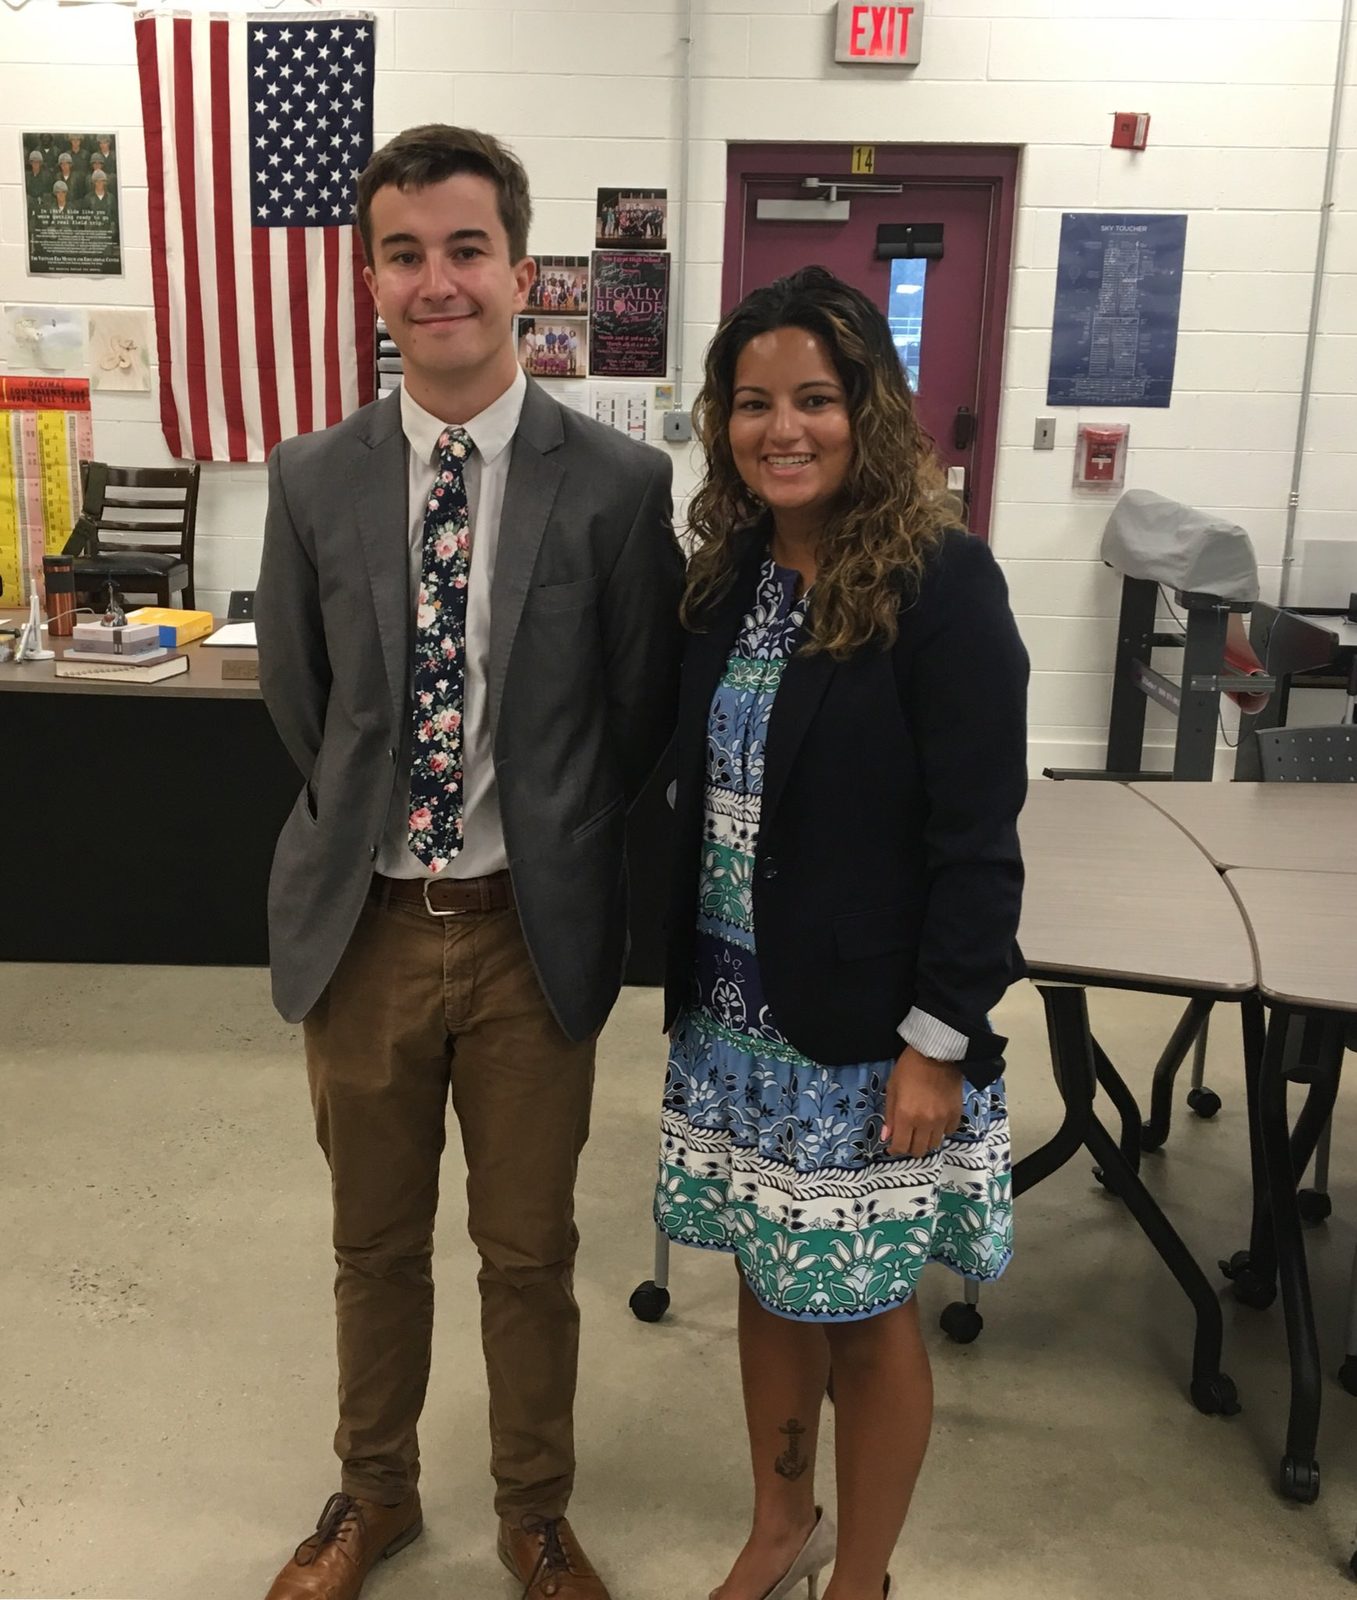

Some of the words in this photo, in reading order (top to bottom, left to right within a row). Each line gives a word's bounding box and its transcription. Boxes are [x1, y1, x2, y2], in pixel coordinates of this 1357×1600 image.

[849, 5, 914, 57] EXIT
[855, 147, 873, 173] 14
[596, 287, 662, 300] LEGALLY
[10, 387, 67, 396] EQUIVALENTS
